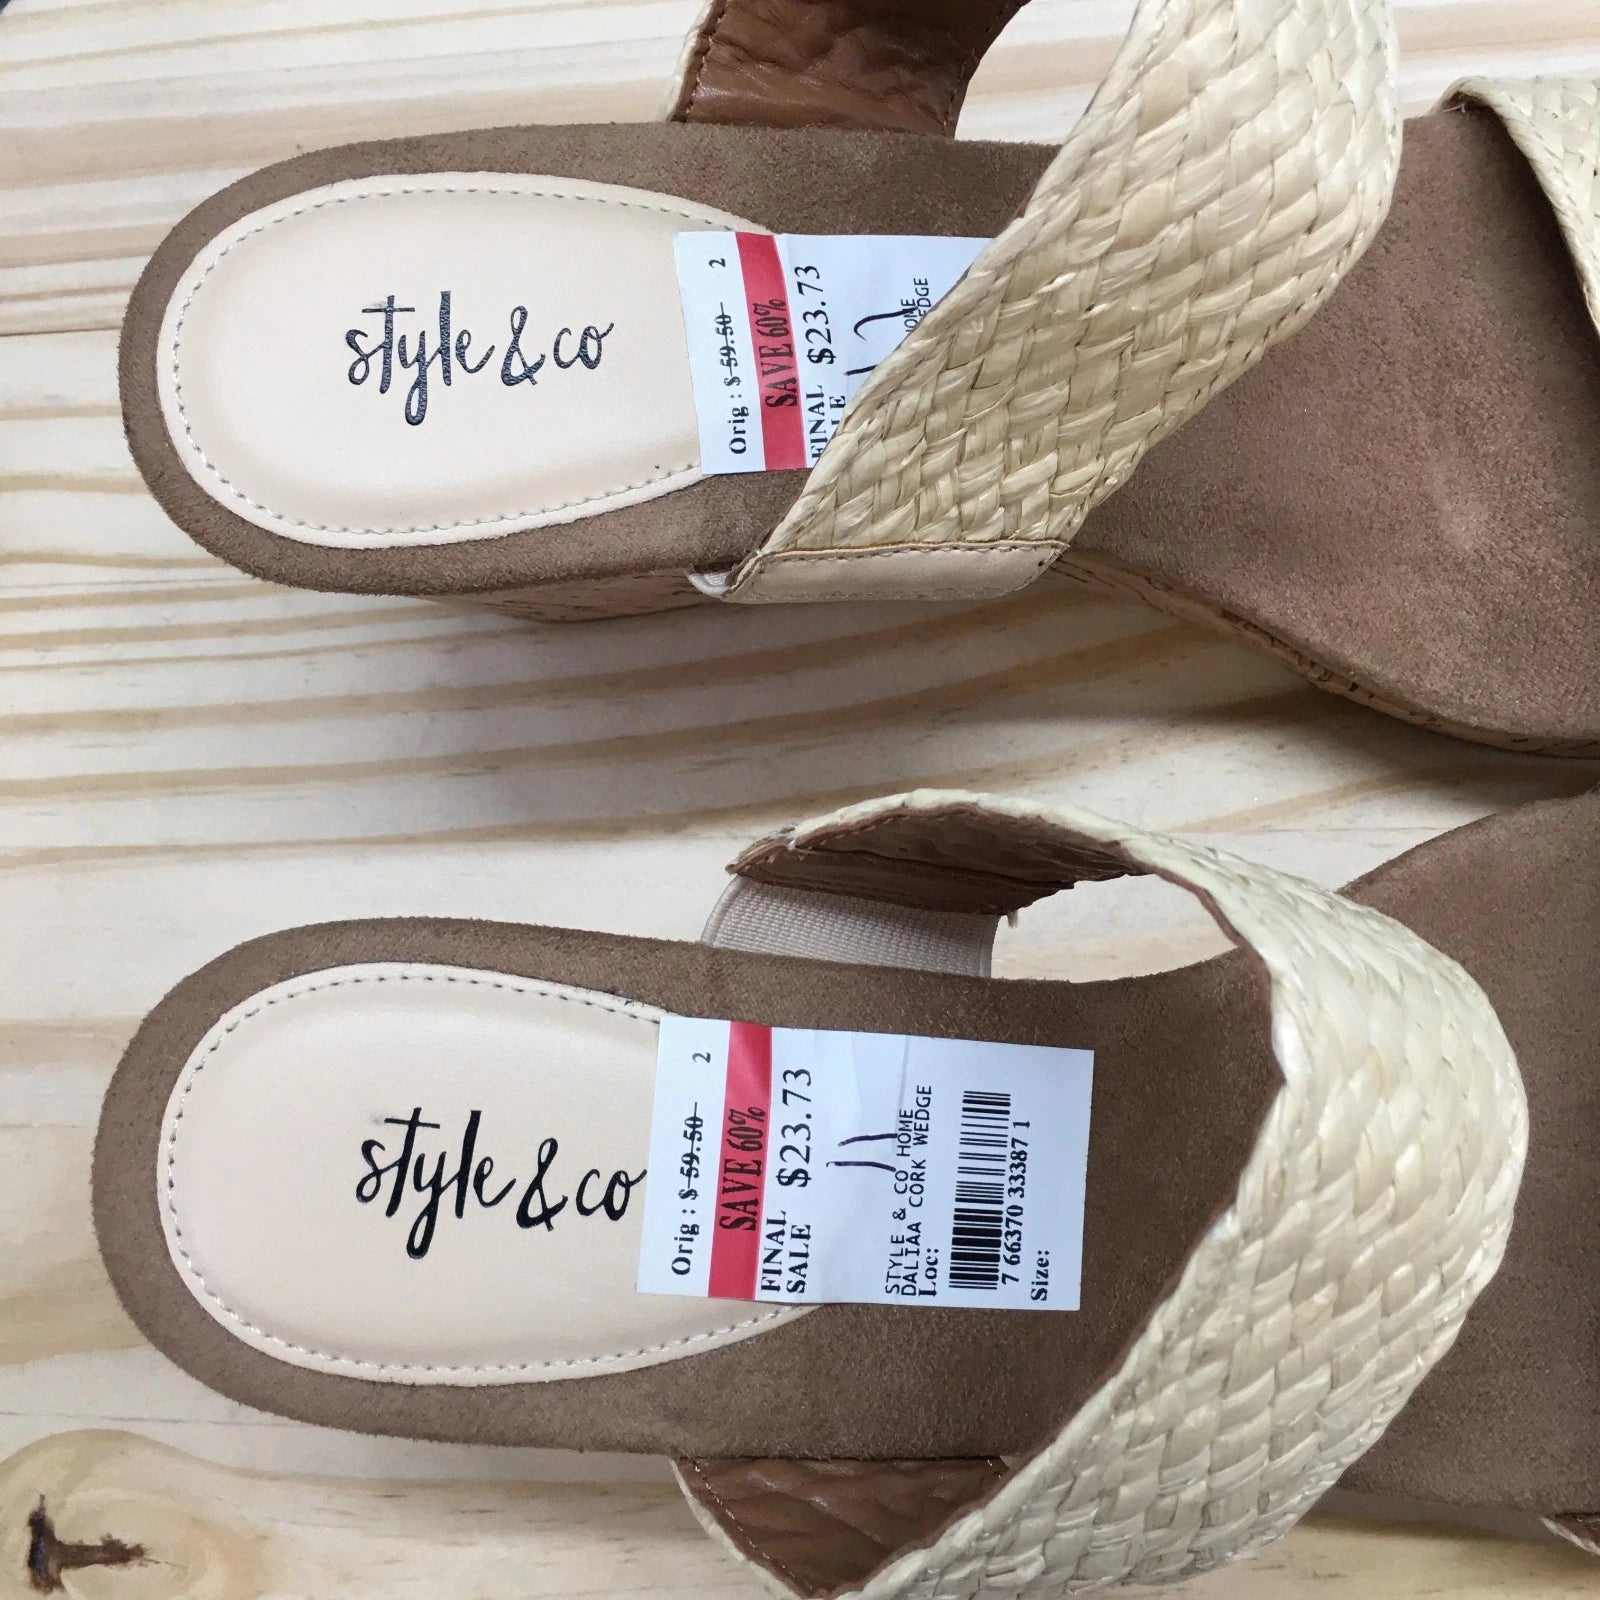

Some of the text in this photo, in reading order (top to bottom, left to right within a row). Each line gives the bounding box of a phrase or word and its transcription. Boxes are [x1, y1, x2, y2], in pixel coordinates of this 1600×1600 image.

[708, 257, 726, 268] 2
[794, 265, 837, 365] $23.73
[345, 290, 615, 426] style & co
[752, 298, 798, 409] SAVE 60%
[692, 1052, 712, 1064] 2
[356, 1106, 647, 1260] style & co
[719, 1106, 766, 1231] SAVE 60%
[776, 1068, 812, 1187] $23.73
[885, 1109, 914, 1295] STYLE & CO HOME
[901, 1085, 932, 1296] DALIAA CORK WEDGE
[1001, 1120, 1030, 1285] 7 66370 33387 1
[761, 1210, 787, 1292] FINAL
[787, 1224, 812, 1294] SALE
[918, 1248, 940, 1297] Loc:
[1030, 1250, 1050, 1302] Size:
